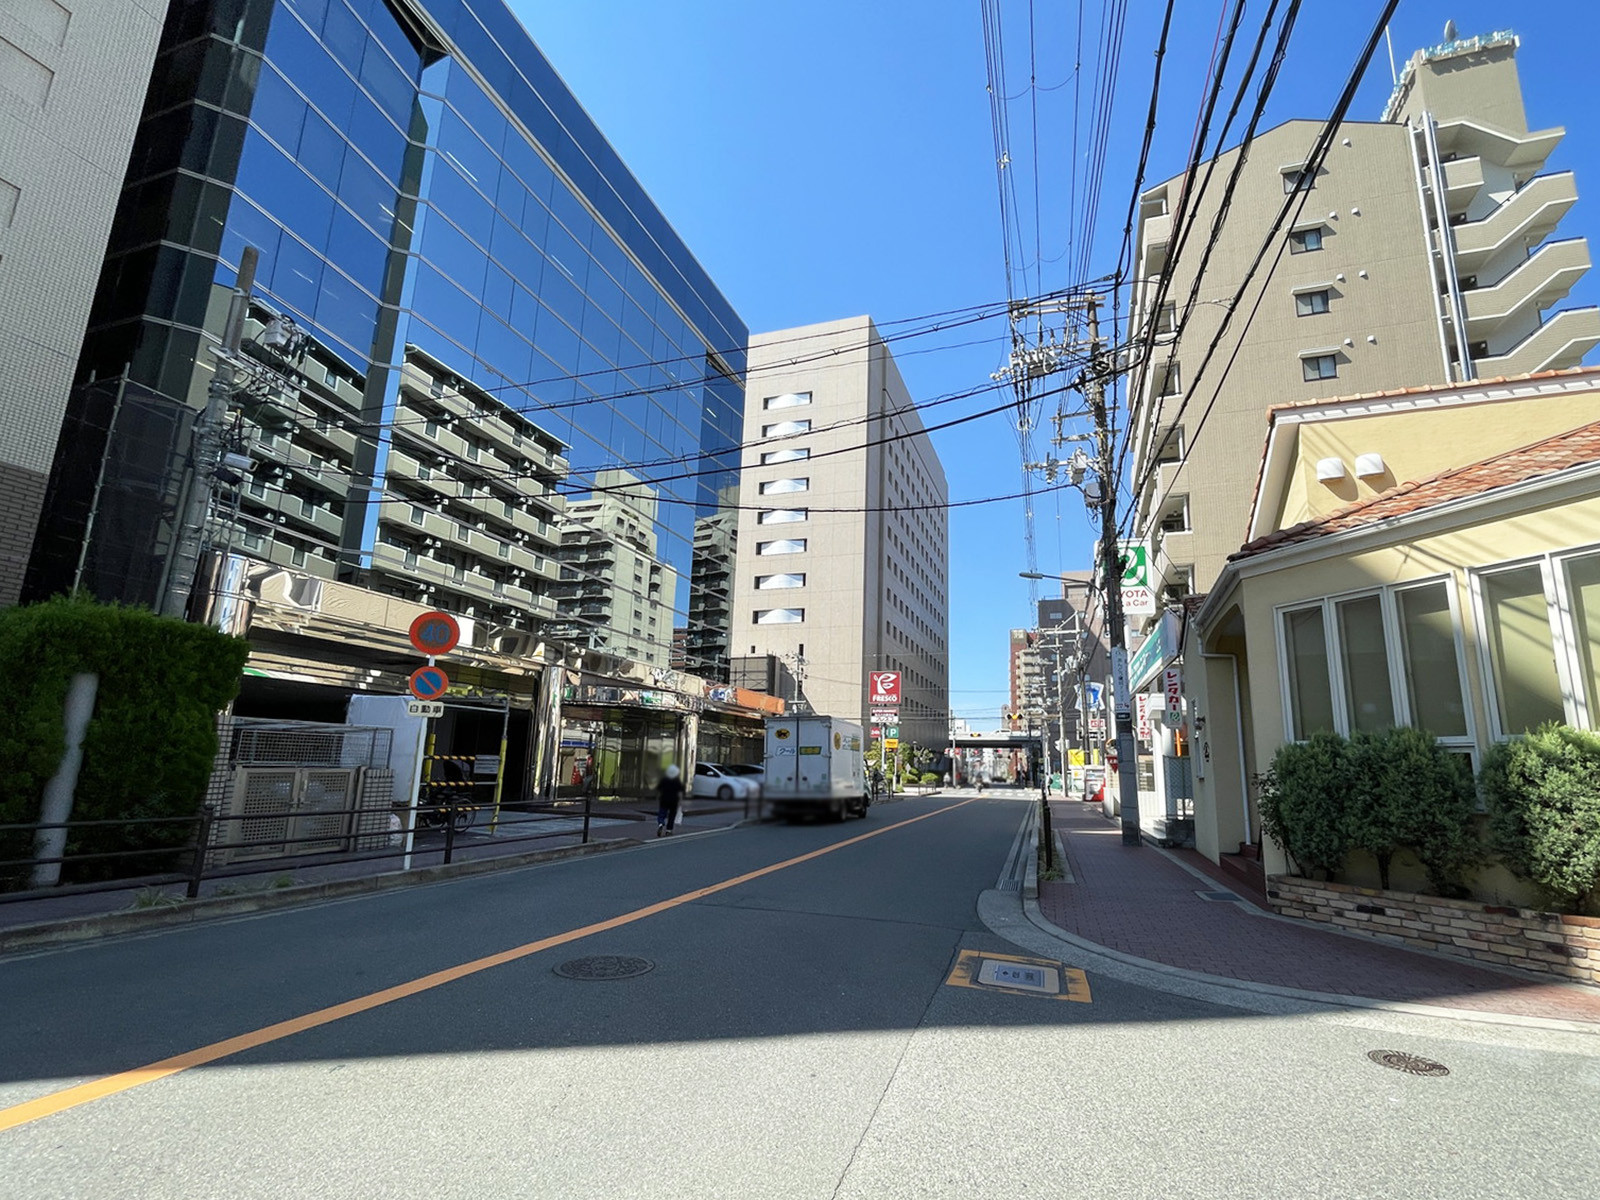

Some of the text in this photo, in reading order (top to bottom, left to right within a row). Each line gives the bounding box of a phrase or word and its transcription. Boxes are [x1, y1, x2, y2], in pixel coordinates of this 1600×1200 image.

[1104, 590, 1148, 598] TYOTA
[1133, 599, 1148, 607] Car
[420, 623, 451, 644] 40
[1167, 671, 1180, 711] レンタカー
[872, 694, 898, 702] FRESCO
[409, 704, 442, 714] 自動車
[890, 728, 897, 736] P
